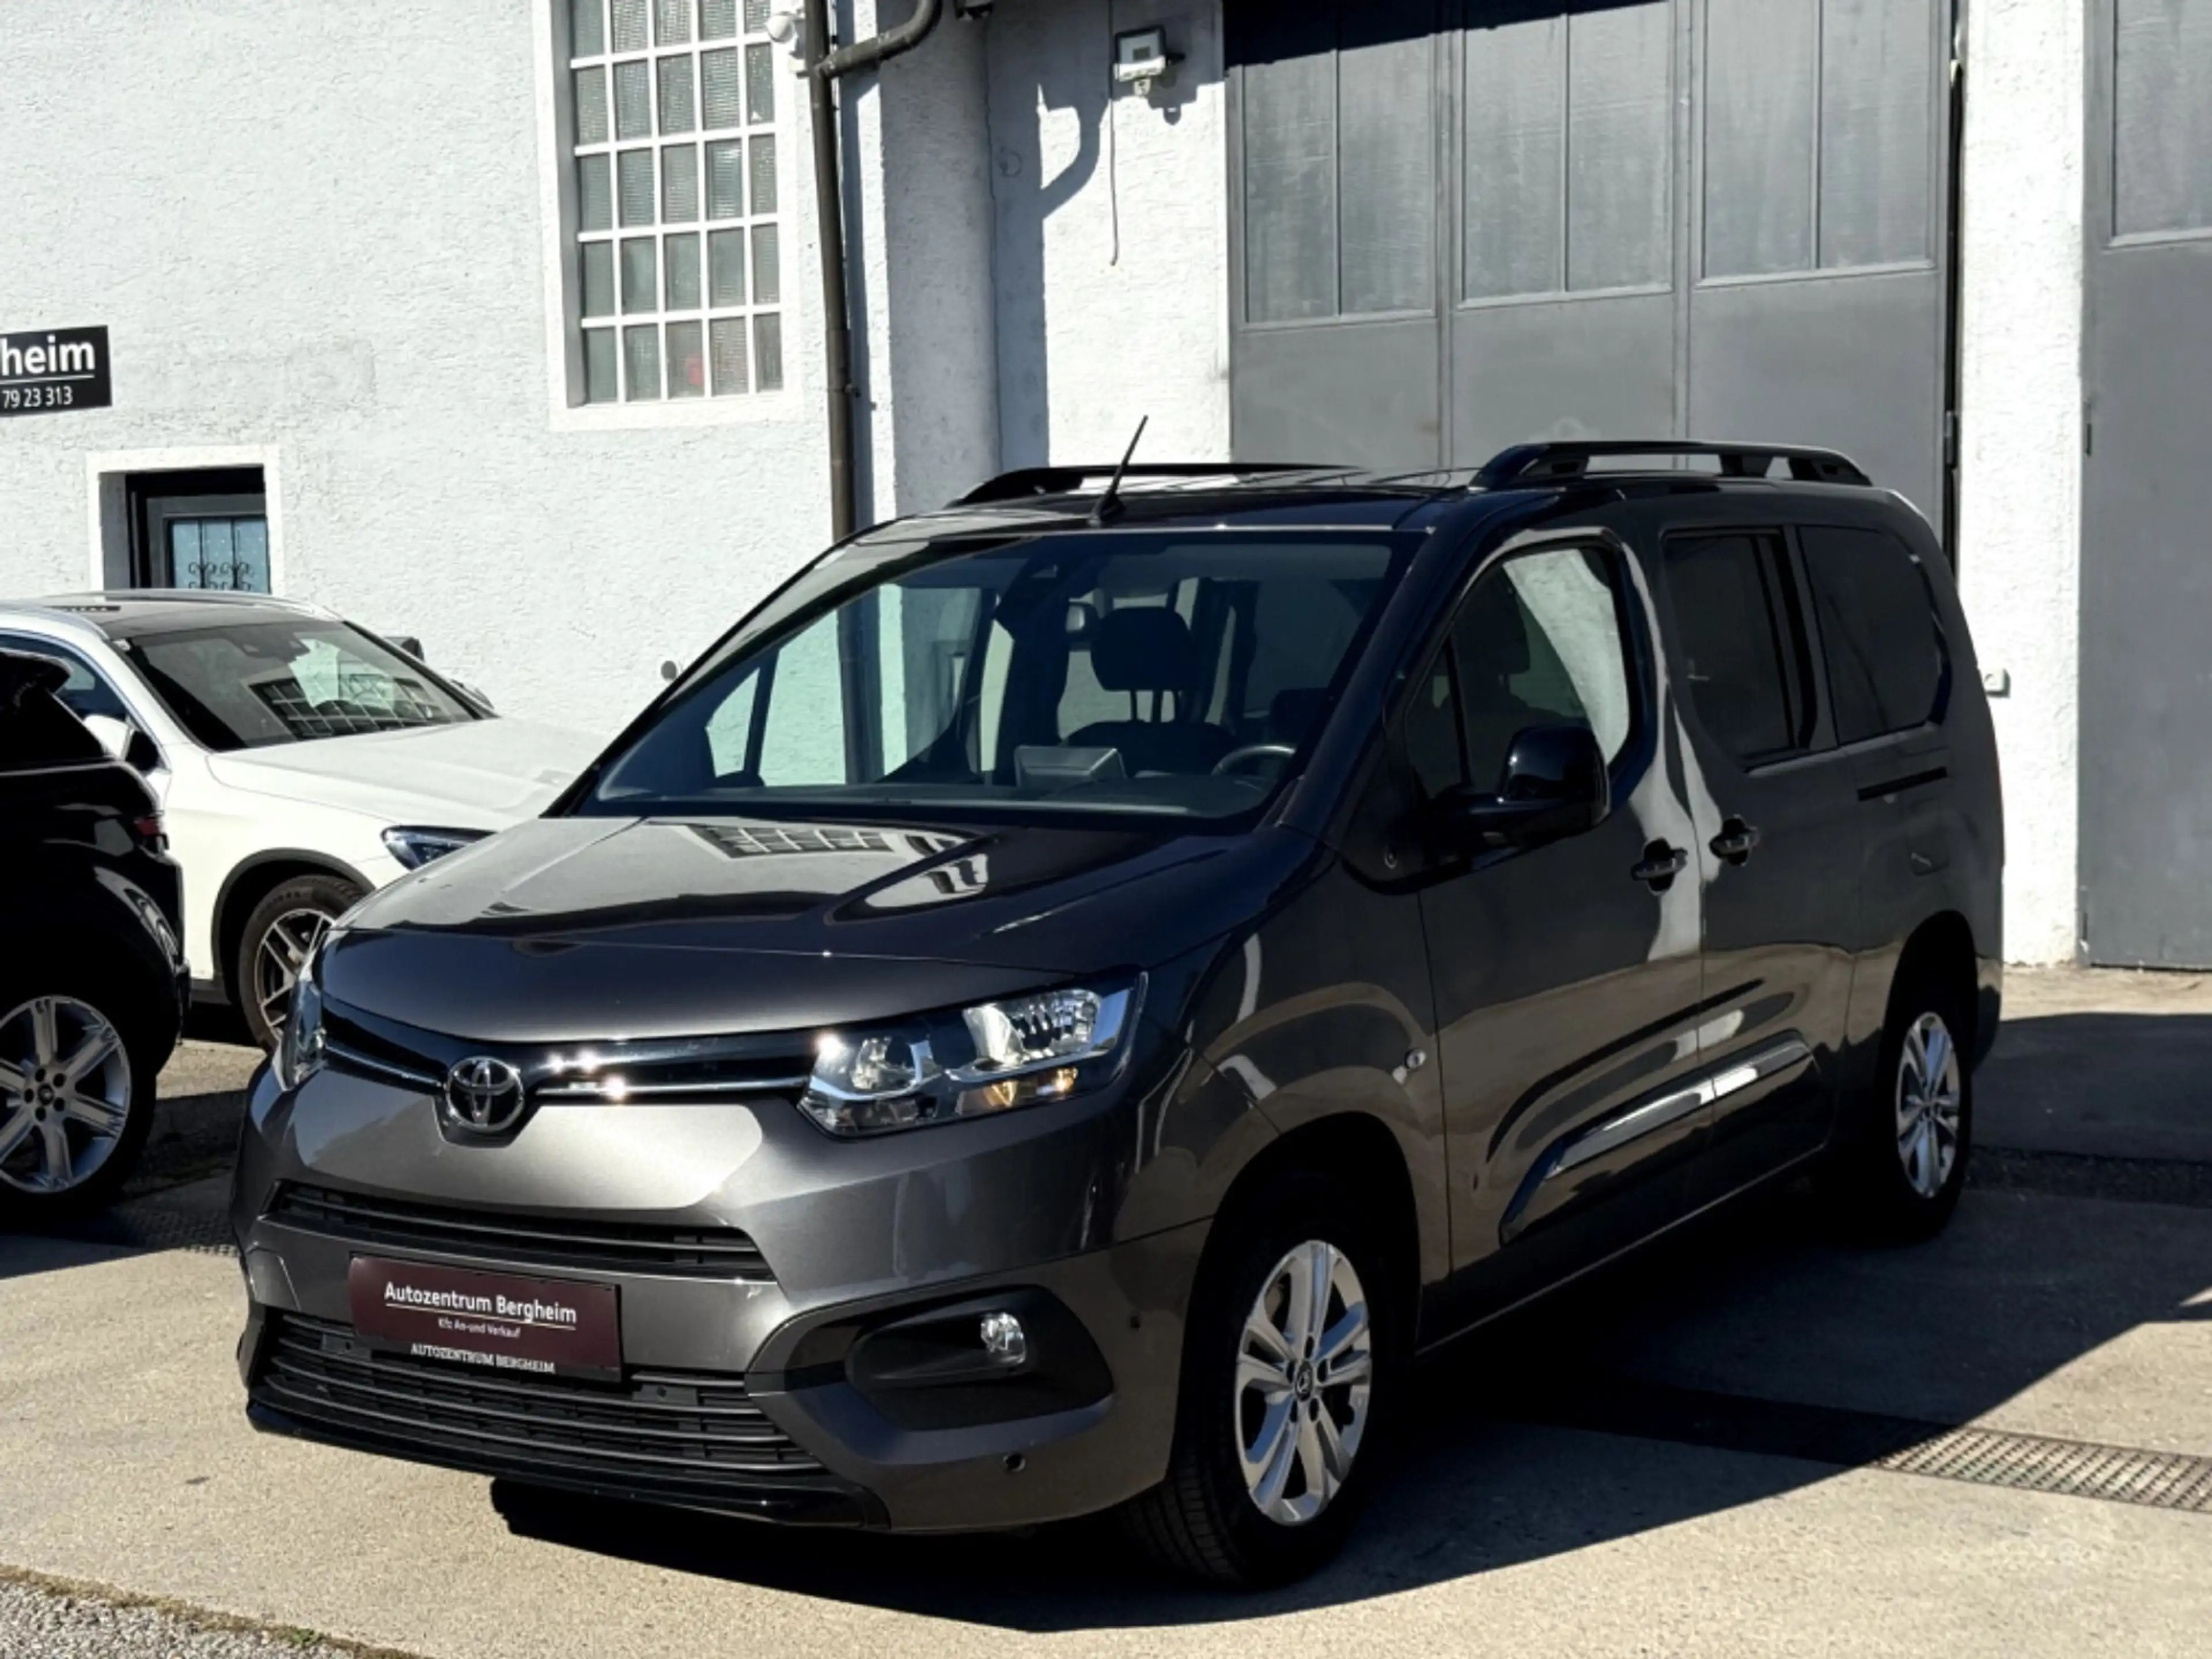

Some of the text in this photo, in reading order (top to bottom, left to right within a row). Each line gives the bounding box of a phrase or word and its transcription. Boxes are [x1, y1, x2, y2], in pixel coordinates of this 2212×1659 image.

[2, 385, 73, 409] 79 23 313
[384, 1282, 576, 1323] Autozentrum Bergheim
[411, 1343, 555, 1373] AUTOZENTRUM BERGHEIM
